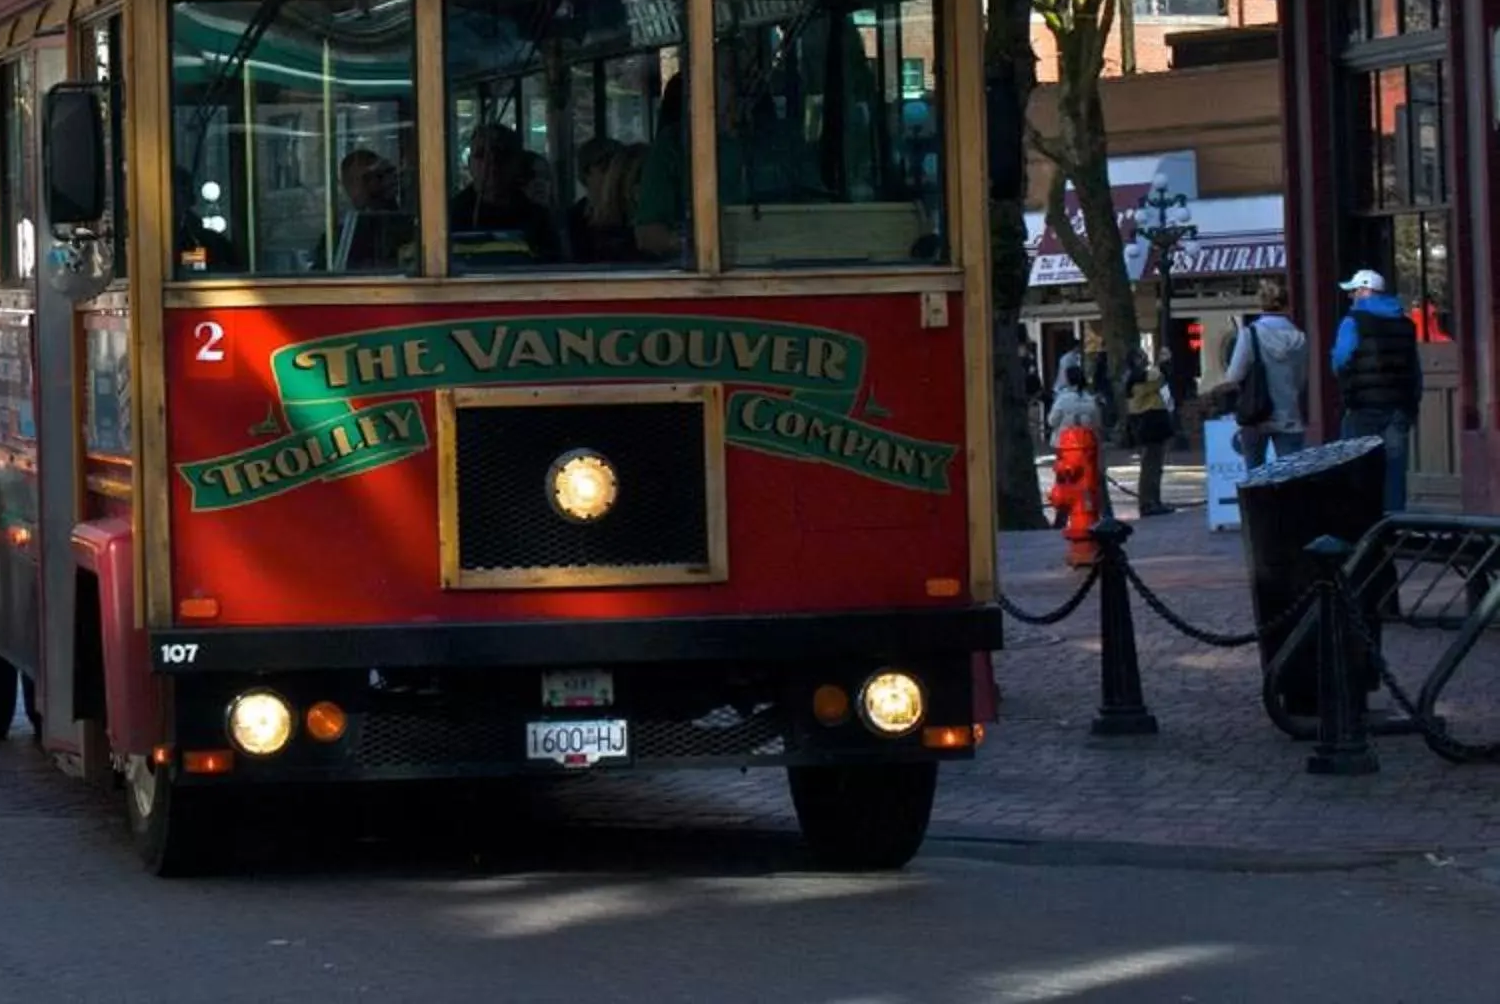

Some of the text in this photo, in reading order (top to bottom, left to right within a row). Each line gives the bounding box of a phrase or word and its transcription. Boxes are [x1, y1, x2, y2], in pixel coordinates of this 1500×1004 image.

[194, 321, 225, 362] 2
[294, 326, 846, 387] THE VANCOUVER
[201, 407, 415, 496] TROLLEY
[740, 396, 946, 481] COMPANY
[160, 643, 199, 663] 107
